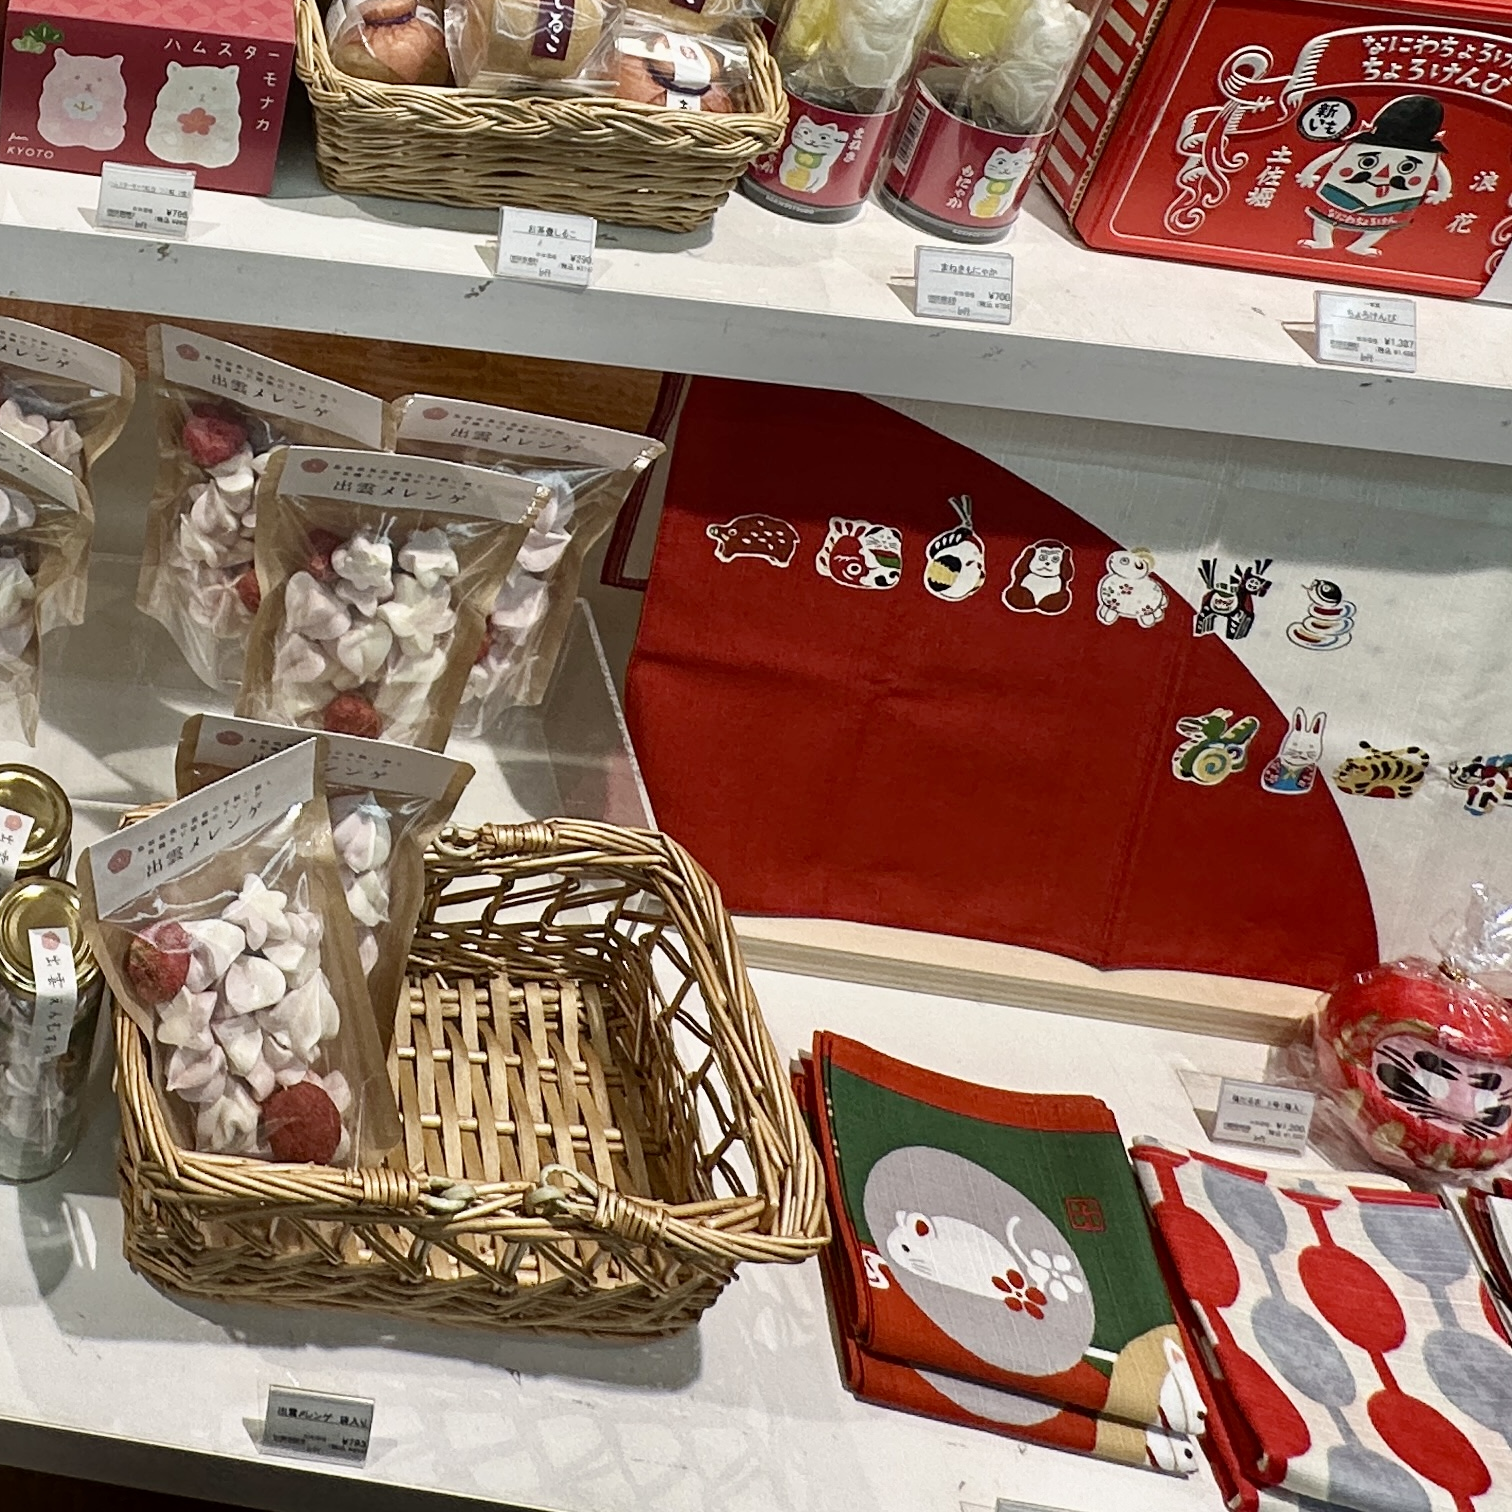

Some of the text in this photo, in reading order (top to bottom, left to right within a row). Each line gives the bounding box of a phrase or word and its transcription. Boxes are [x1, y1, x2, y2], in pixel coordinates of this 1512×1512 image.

[164, 38, 280, 60] ハムスター
[256, 72, 277, 132] モナカ
[1315, 103, 1340, 119] 新
[1308, 118, 1337, 135] いも
[7, 146, 54, 159] KYOTO
[940, 262, 998, 277] まねきもにゃか
[989, 291, 1011, 302] ¥700
[334, 479, 467, 504] 出雲メレンゲ
[147, 802, 259, 878] 出雲メレンゲ
